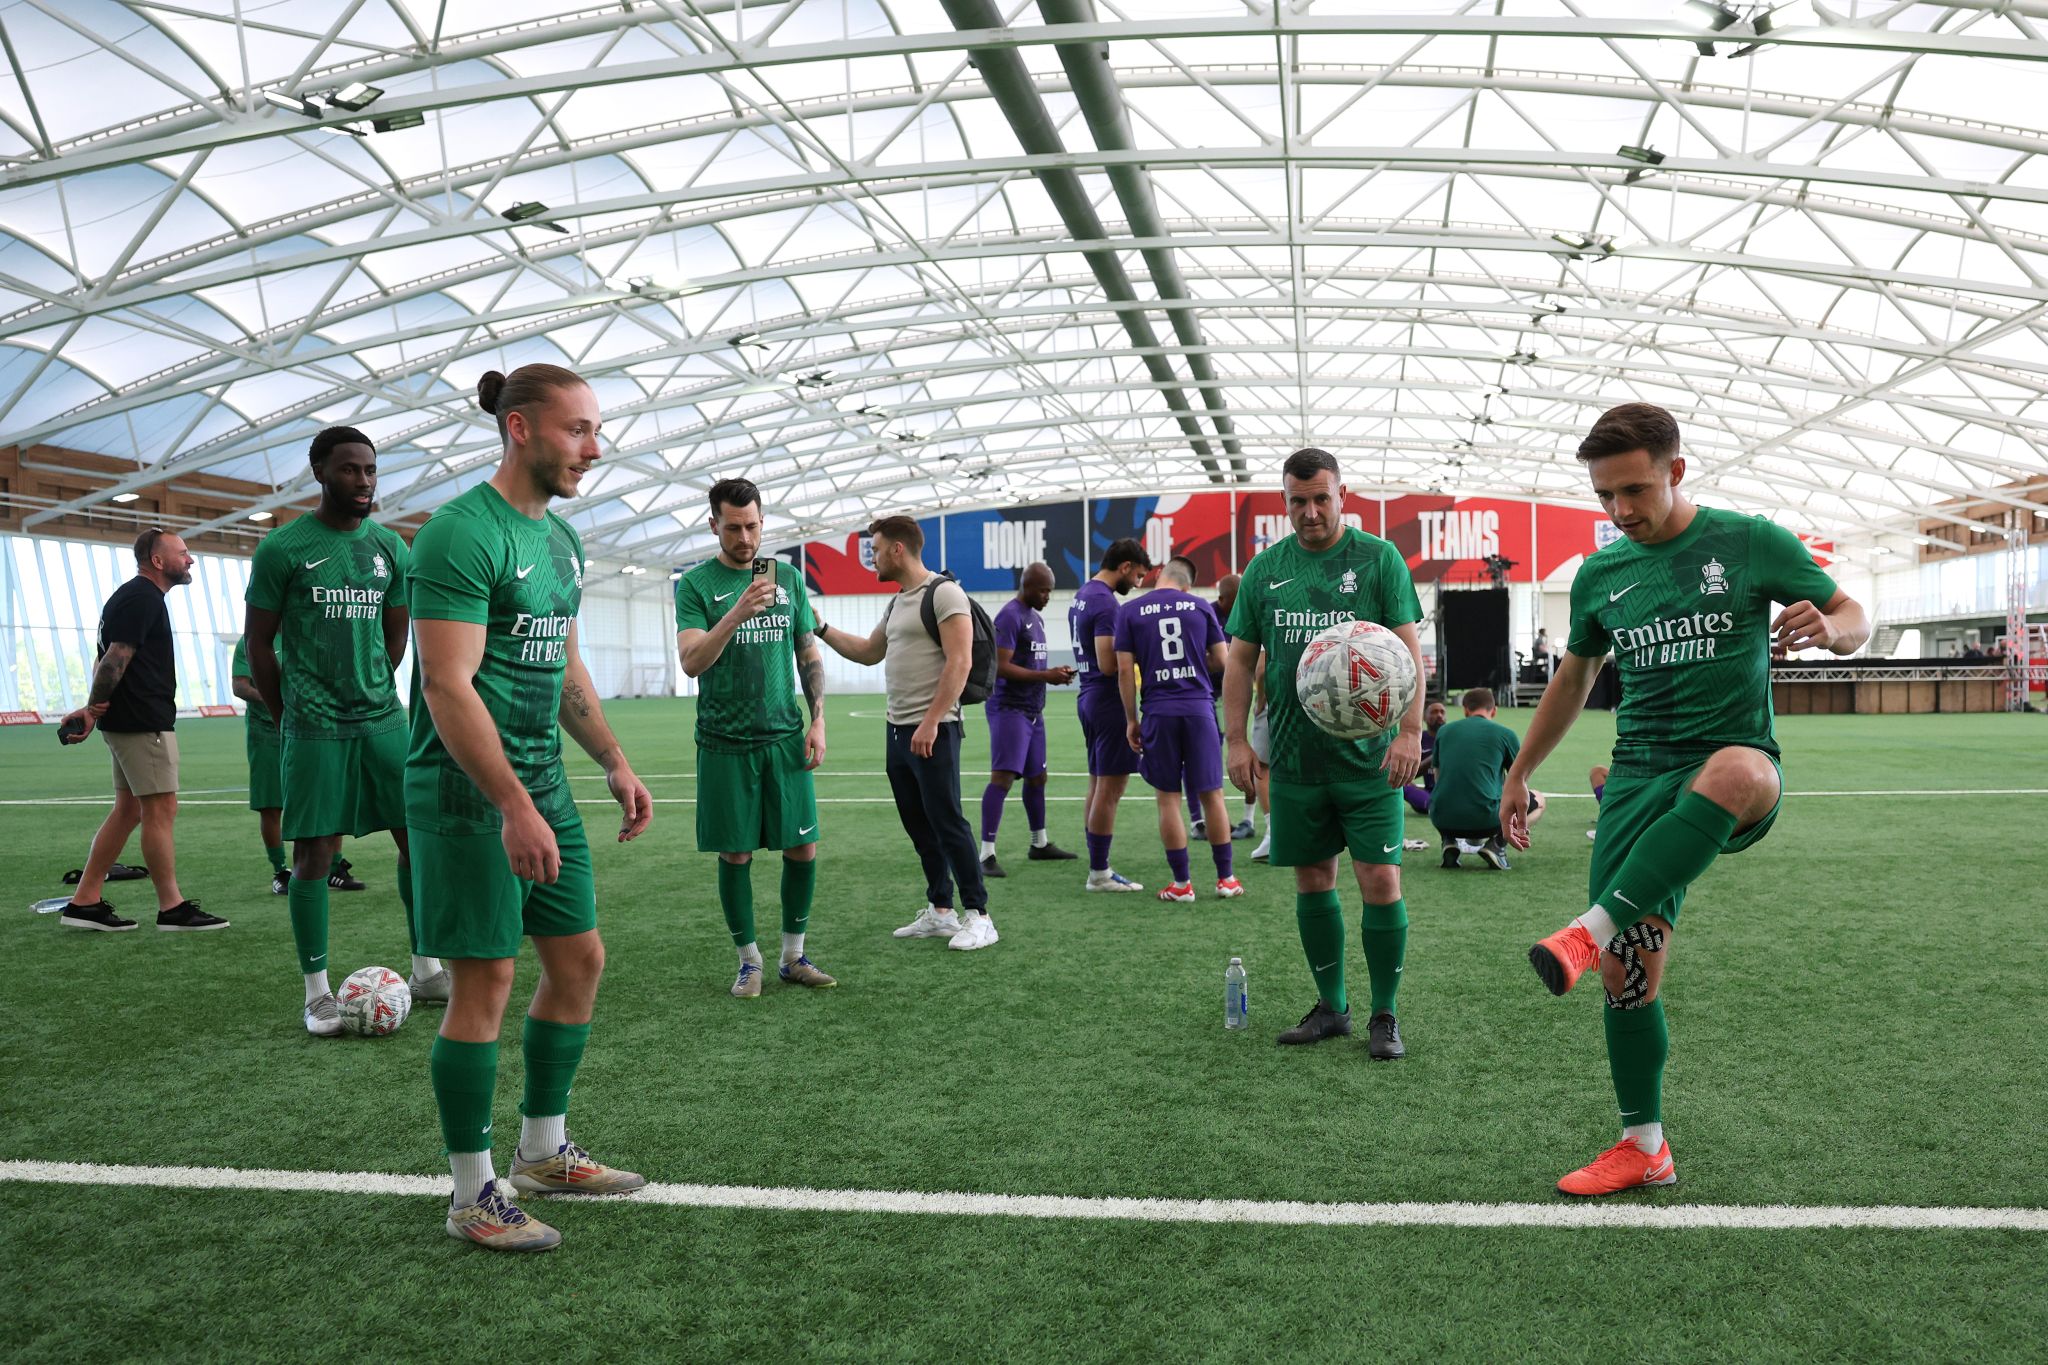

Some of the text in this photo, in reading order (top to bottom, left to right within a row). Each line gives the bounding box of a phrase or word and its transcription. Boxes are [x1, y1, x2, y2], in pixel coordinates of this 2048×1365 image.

[983, 520, 1048, 569] HOME
[1145, 517, 1175, 566] OF
[1418, 509, 1500, 561] TEAMS
[325, 605, 378, 619] FLY BETTER
[1140, 601, 1196, 616] LON DPS
[510, 611, 575, 638] Emirat
[1612, 611, 1733, 652] Emirates
[736, 629, 784, 644] FLY BETTER
[1158, 616, 1185, 661] 8
[1284, 629, 1302, 644] FLY
[521, 640, 543, 662] FLY
[1634, 637, 1716, 668] FLY BETTER
[1155, 665, 1197, 682] TO BALI
